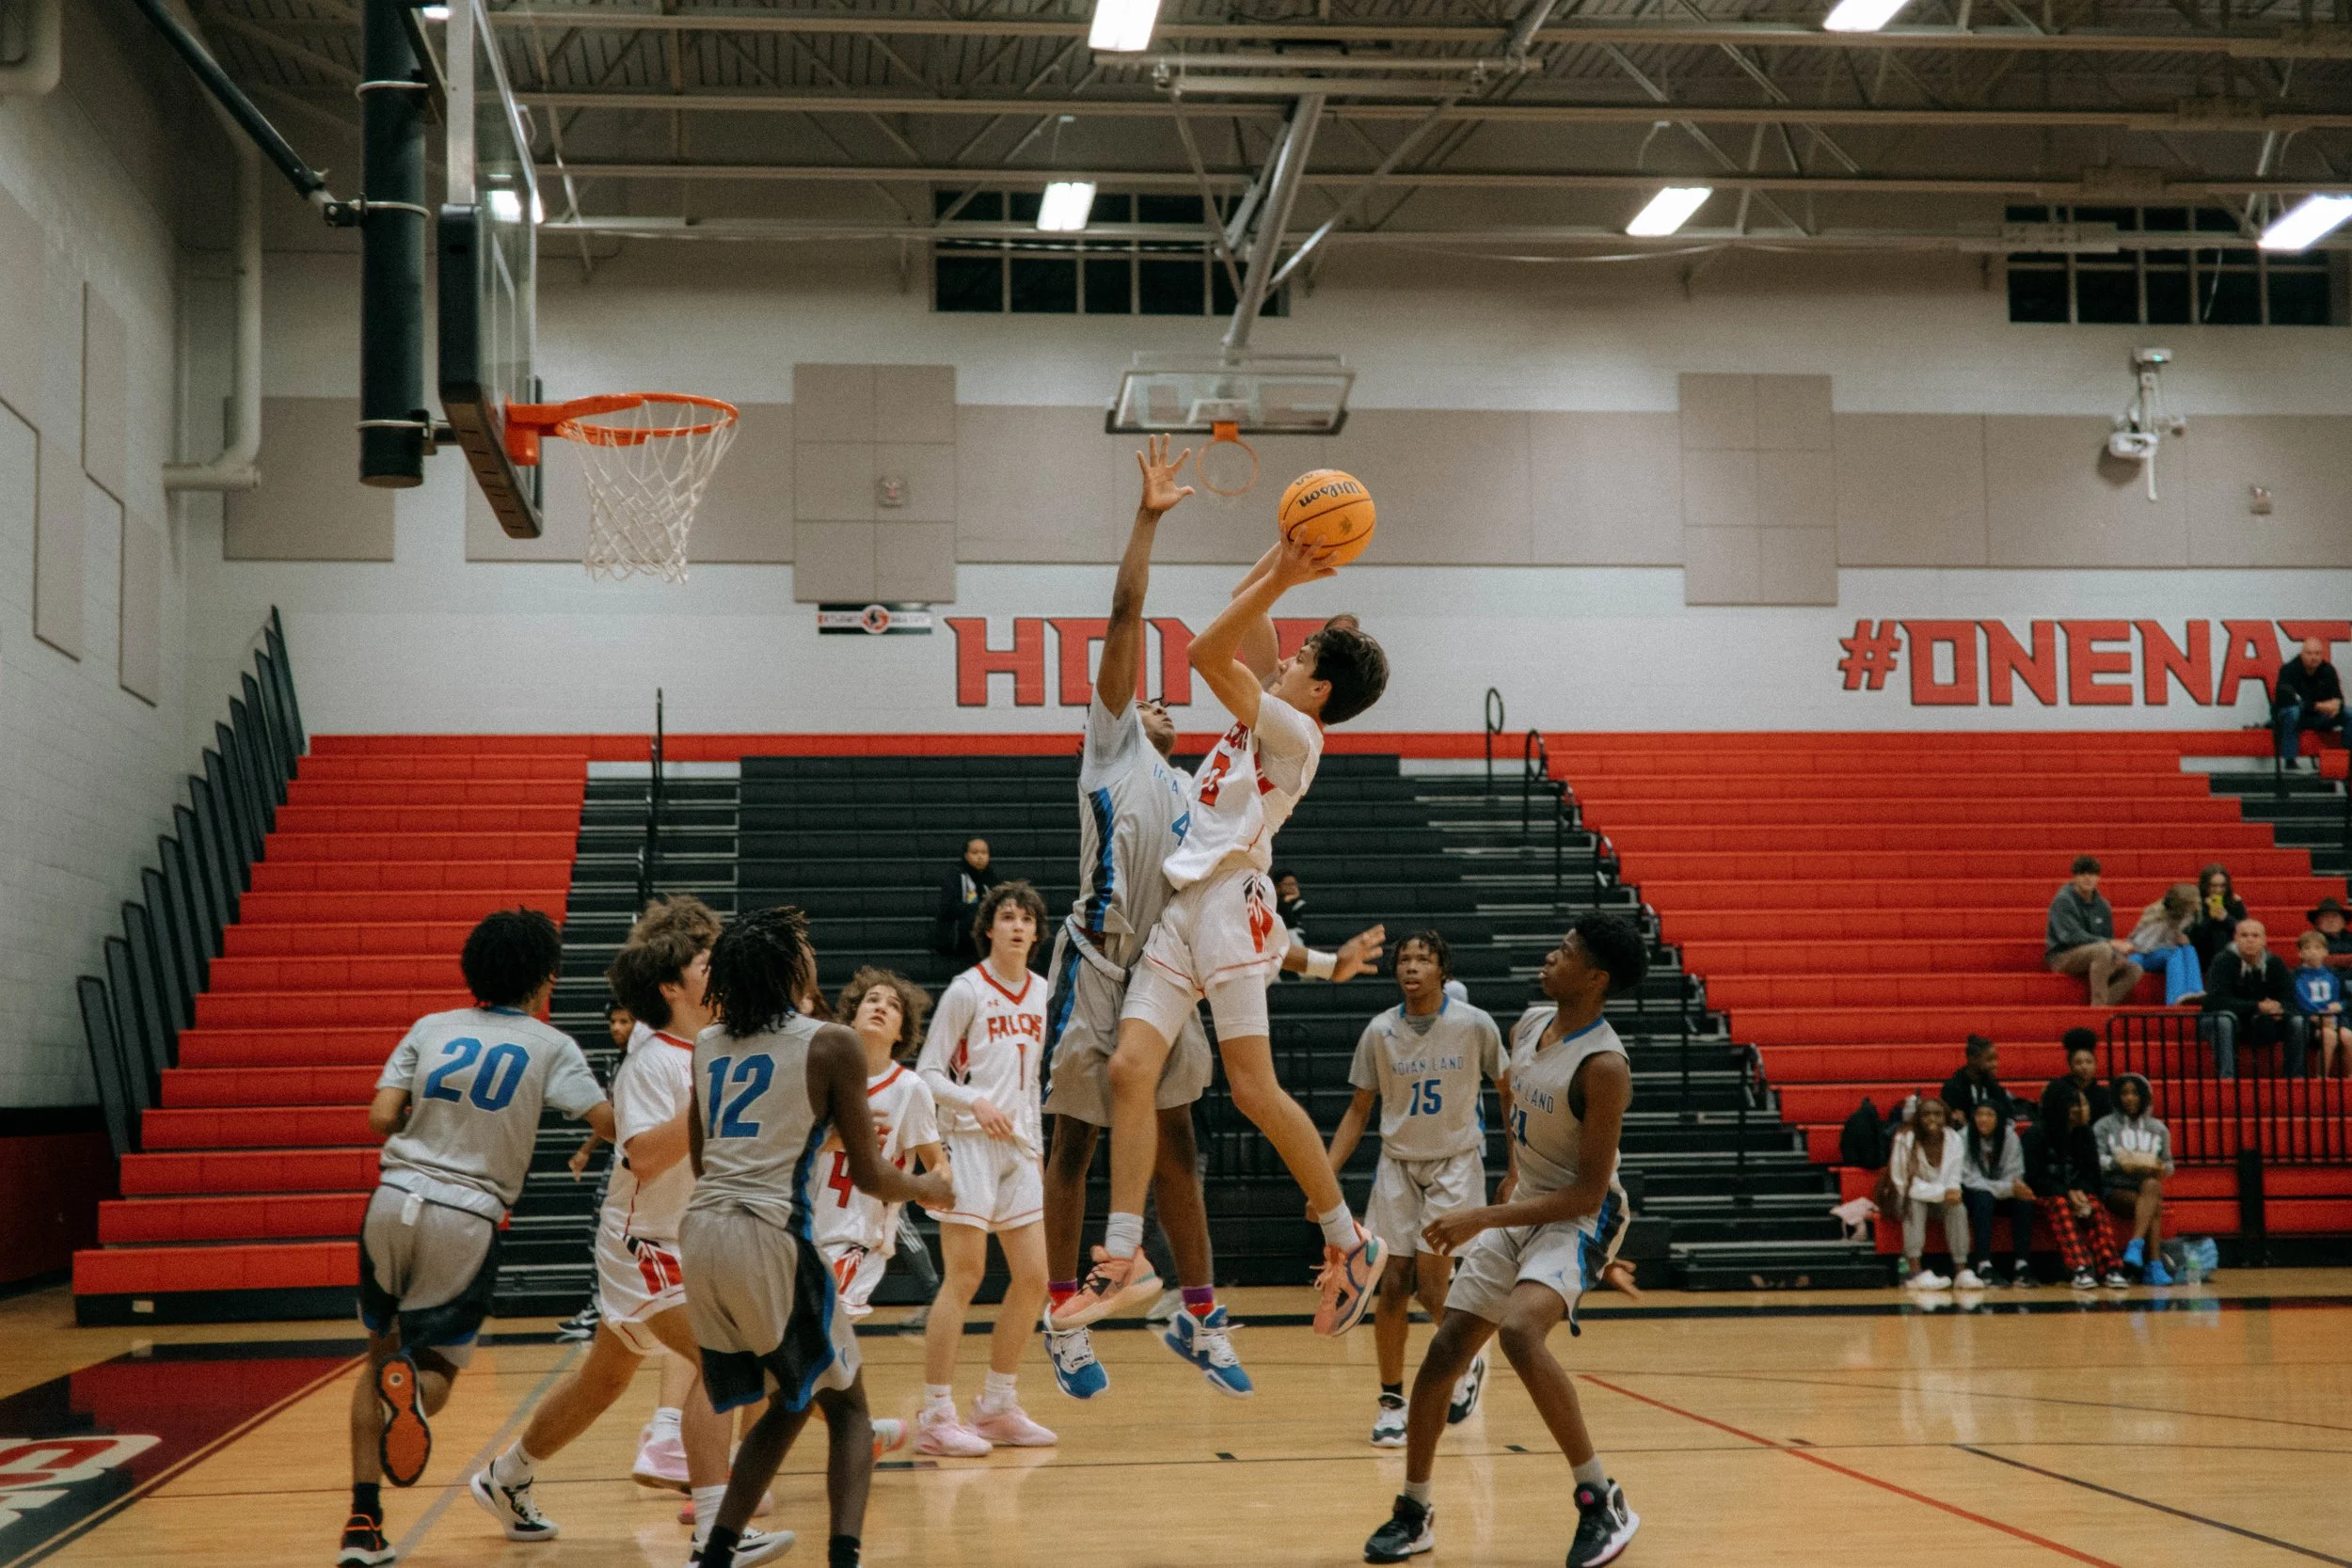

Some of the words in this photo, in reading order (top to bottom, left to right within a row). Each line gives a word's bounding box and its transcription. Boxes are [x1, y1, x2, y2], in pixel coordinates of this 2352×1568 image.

[1299, 482, 1362, 507] Wilson
[944, 617, 1331, 706] HO
[424, 1037, 531, 1113] 20
[707, 1053, 776, 1139] 12
[1409, 1079, 1442, 1117] 15
[1524, 1082, 1554, 1115] LAND
